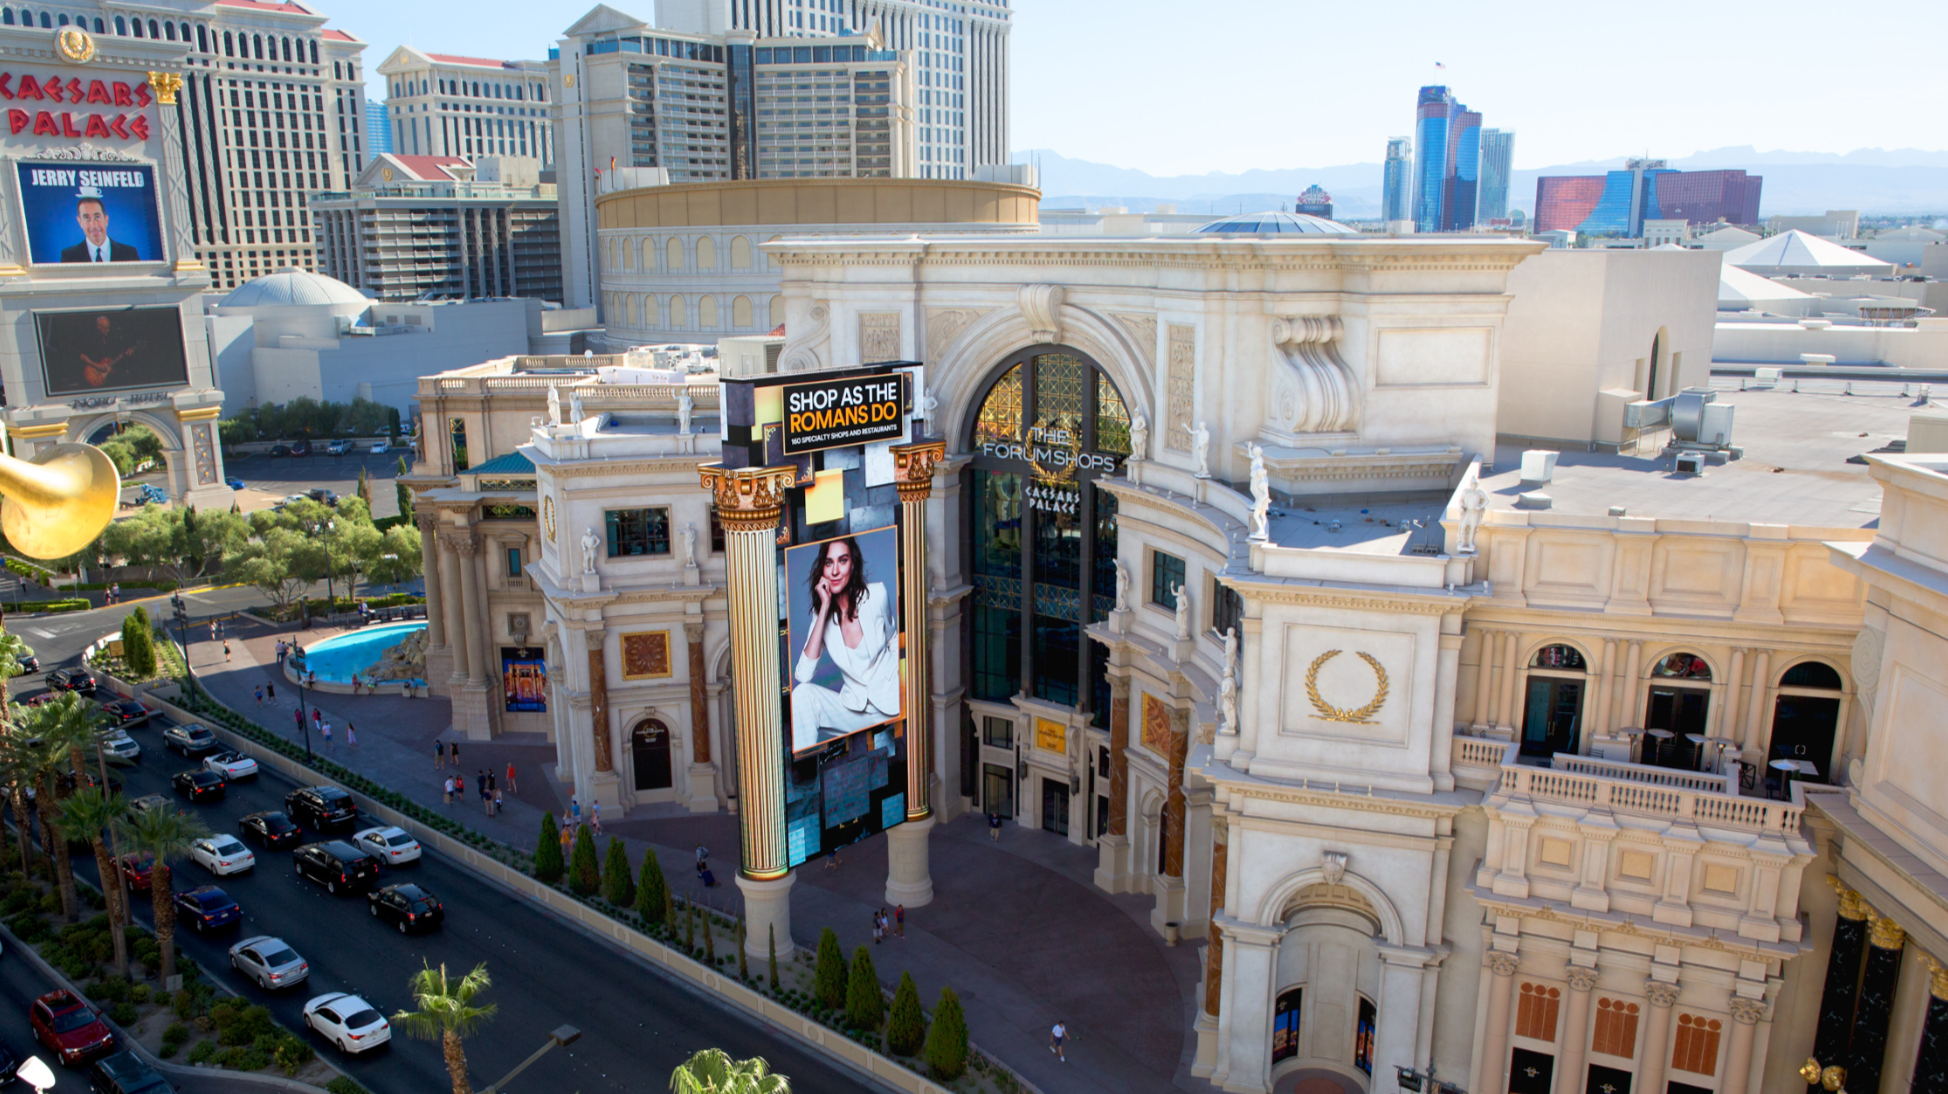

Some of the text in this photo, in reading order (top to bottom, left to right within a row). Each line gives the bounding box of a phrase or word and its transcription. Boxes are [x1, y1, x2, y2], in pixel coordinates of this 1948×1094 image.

[0, 72, 152, 108] CAESARS
[8, 109, 149, 141] PALACE
[32, 169, 145, 188] JERRY SEINFELD
[72, 391, 172, 409] NOBU HOTEL
[789, 382, 897, 412] SHOP AS THE
[790, 401, 897, 433] ROMANS DO
[791, 424, 897, 445] 160 SPECIALTY SHOPS AND RESTAURANTS
[1030, 427, 1070, 445] THE
[984, 443, 1115, 472] FORUM SHOPS
[1025, 486, 1080, 503] CAESARS
[1029, 498, 1075, 515] PALACE
